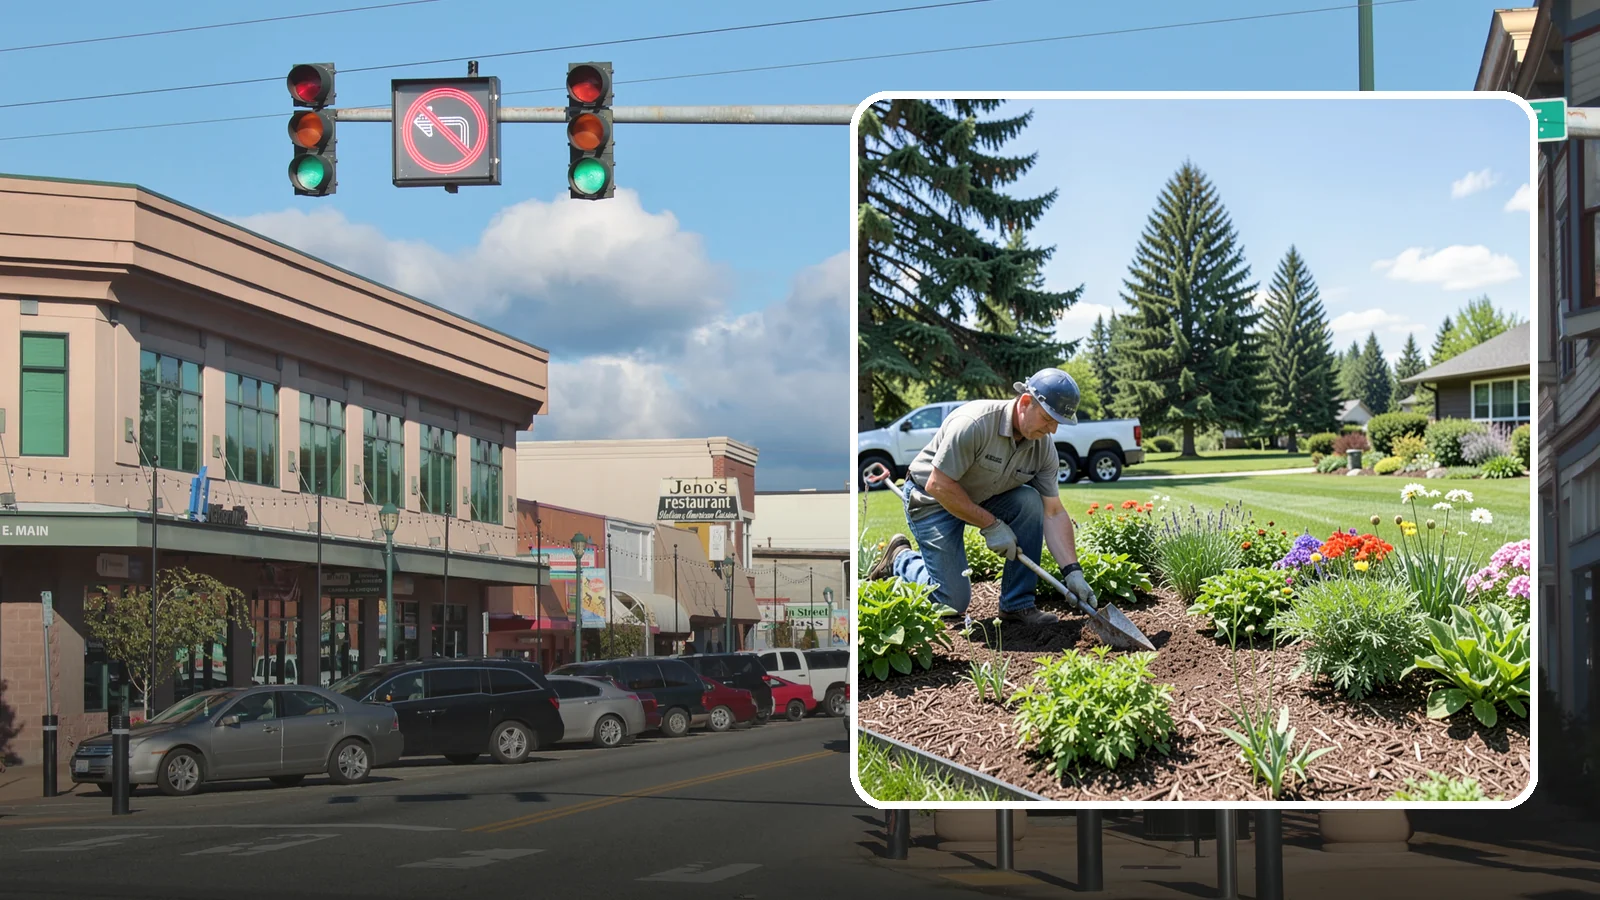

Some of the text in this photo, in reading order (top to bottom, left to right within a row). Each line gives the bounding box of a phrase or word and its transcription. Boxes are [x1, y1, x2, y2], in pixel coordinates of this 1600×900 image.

[669, 480, 727, 494] Jeno's
[665, 496, 731, 509] restaurant
[2, 525, 48, 536] E. MAIN
[797, 607, 828, 617] Street
